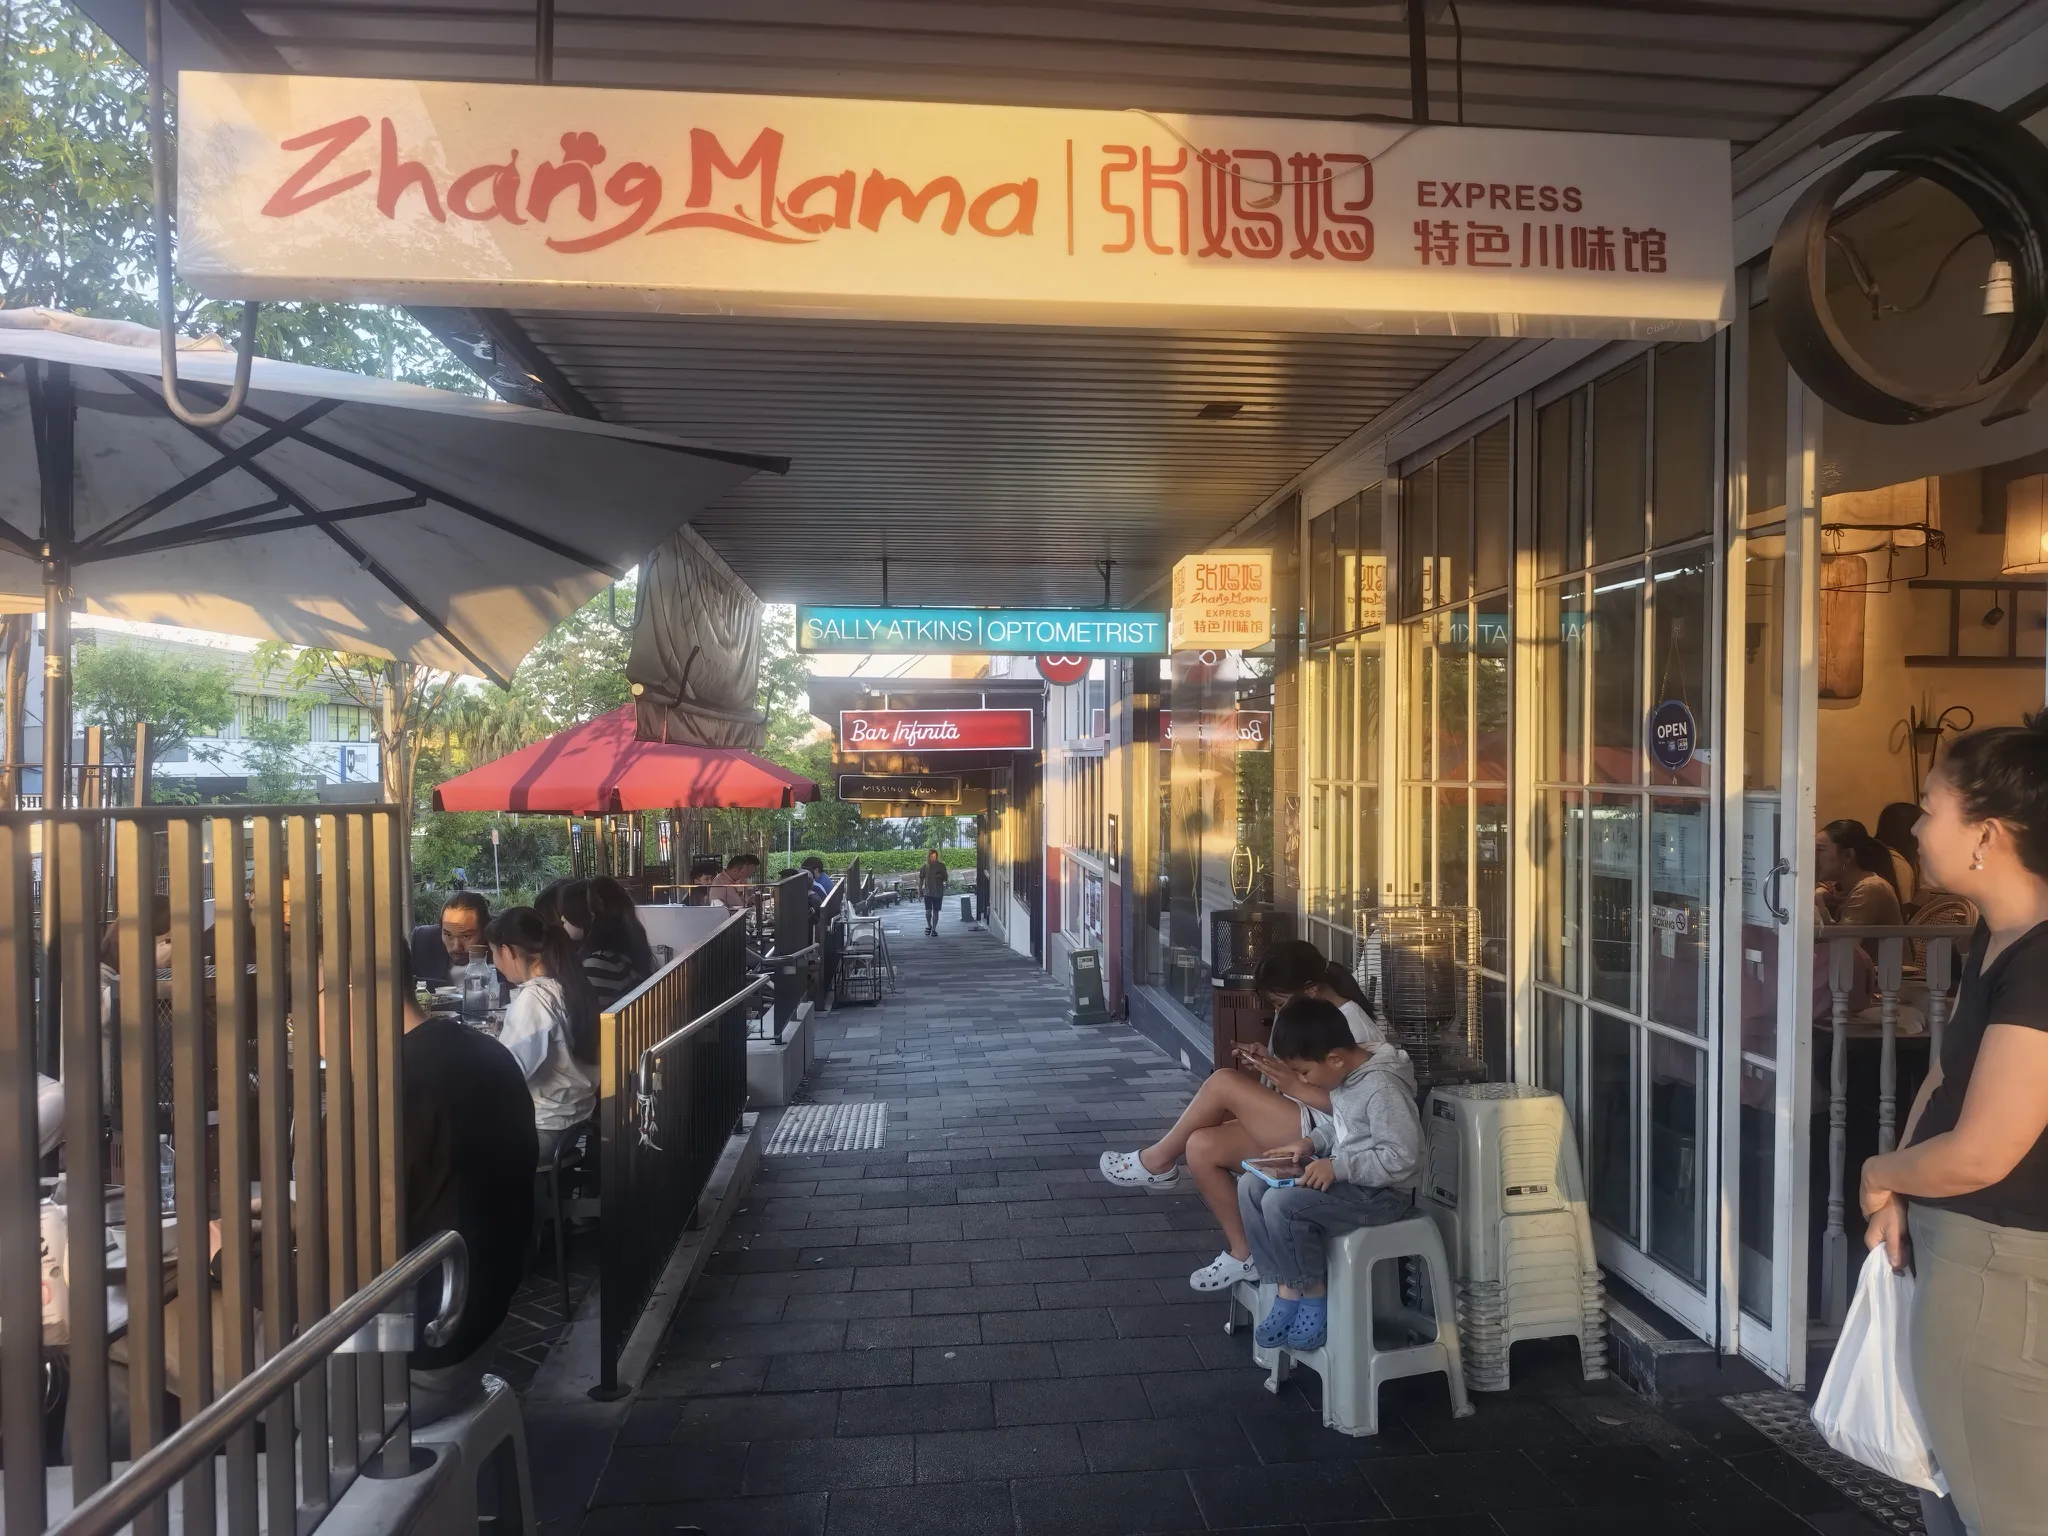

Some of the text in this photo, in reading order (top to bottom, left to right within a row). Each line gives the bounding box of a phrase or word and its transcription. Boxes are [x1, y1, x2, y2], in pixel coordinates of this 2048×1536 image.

[260, 115, 1039, 253] Zhang Mama
[1417, 181, 1582, 213] EXPRESS
[1414, 220, 1667, 273] 特色川味馆
[1190, 591, 1268, 606] Zhang Mama
[1205, 609, 1252, 618] EXPRESS
[808, 618, 882, 639] SALLY
[887, 619, 973, 641] ATKINS
[987, 621, 1158, 643] OPTOMETRIST
[1194, 620, 1263, 633] 特色川味馆
[850, 719, 960, 747] Bar Infinita
[1657, 721, 1687, 739] OPEN
[862, 785, 904, 793] MISSING
